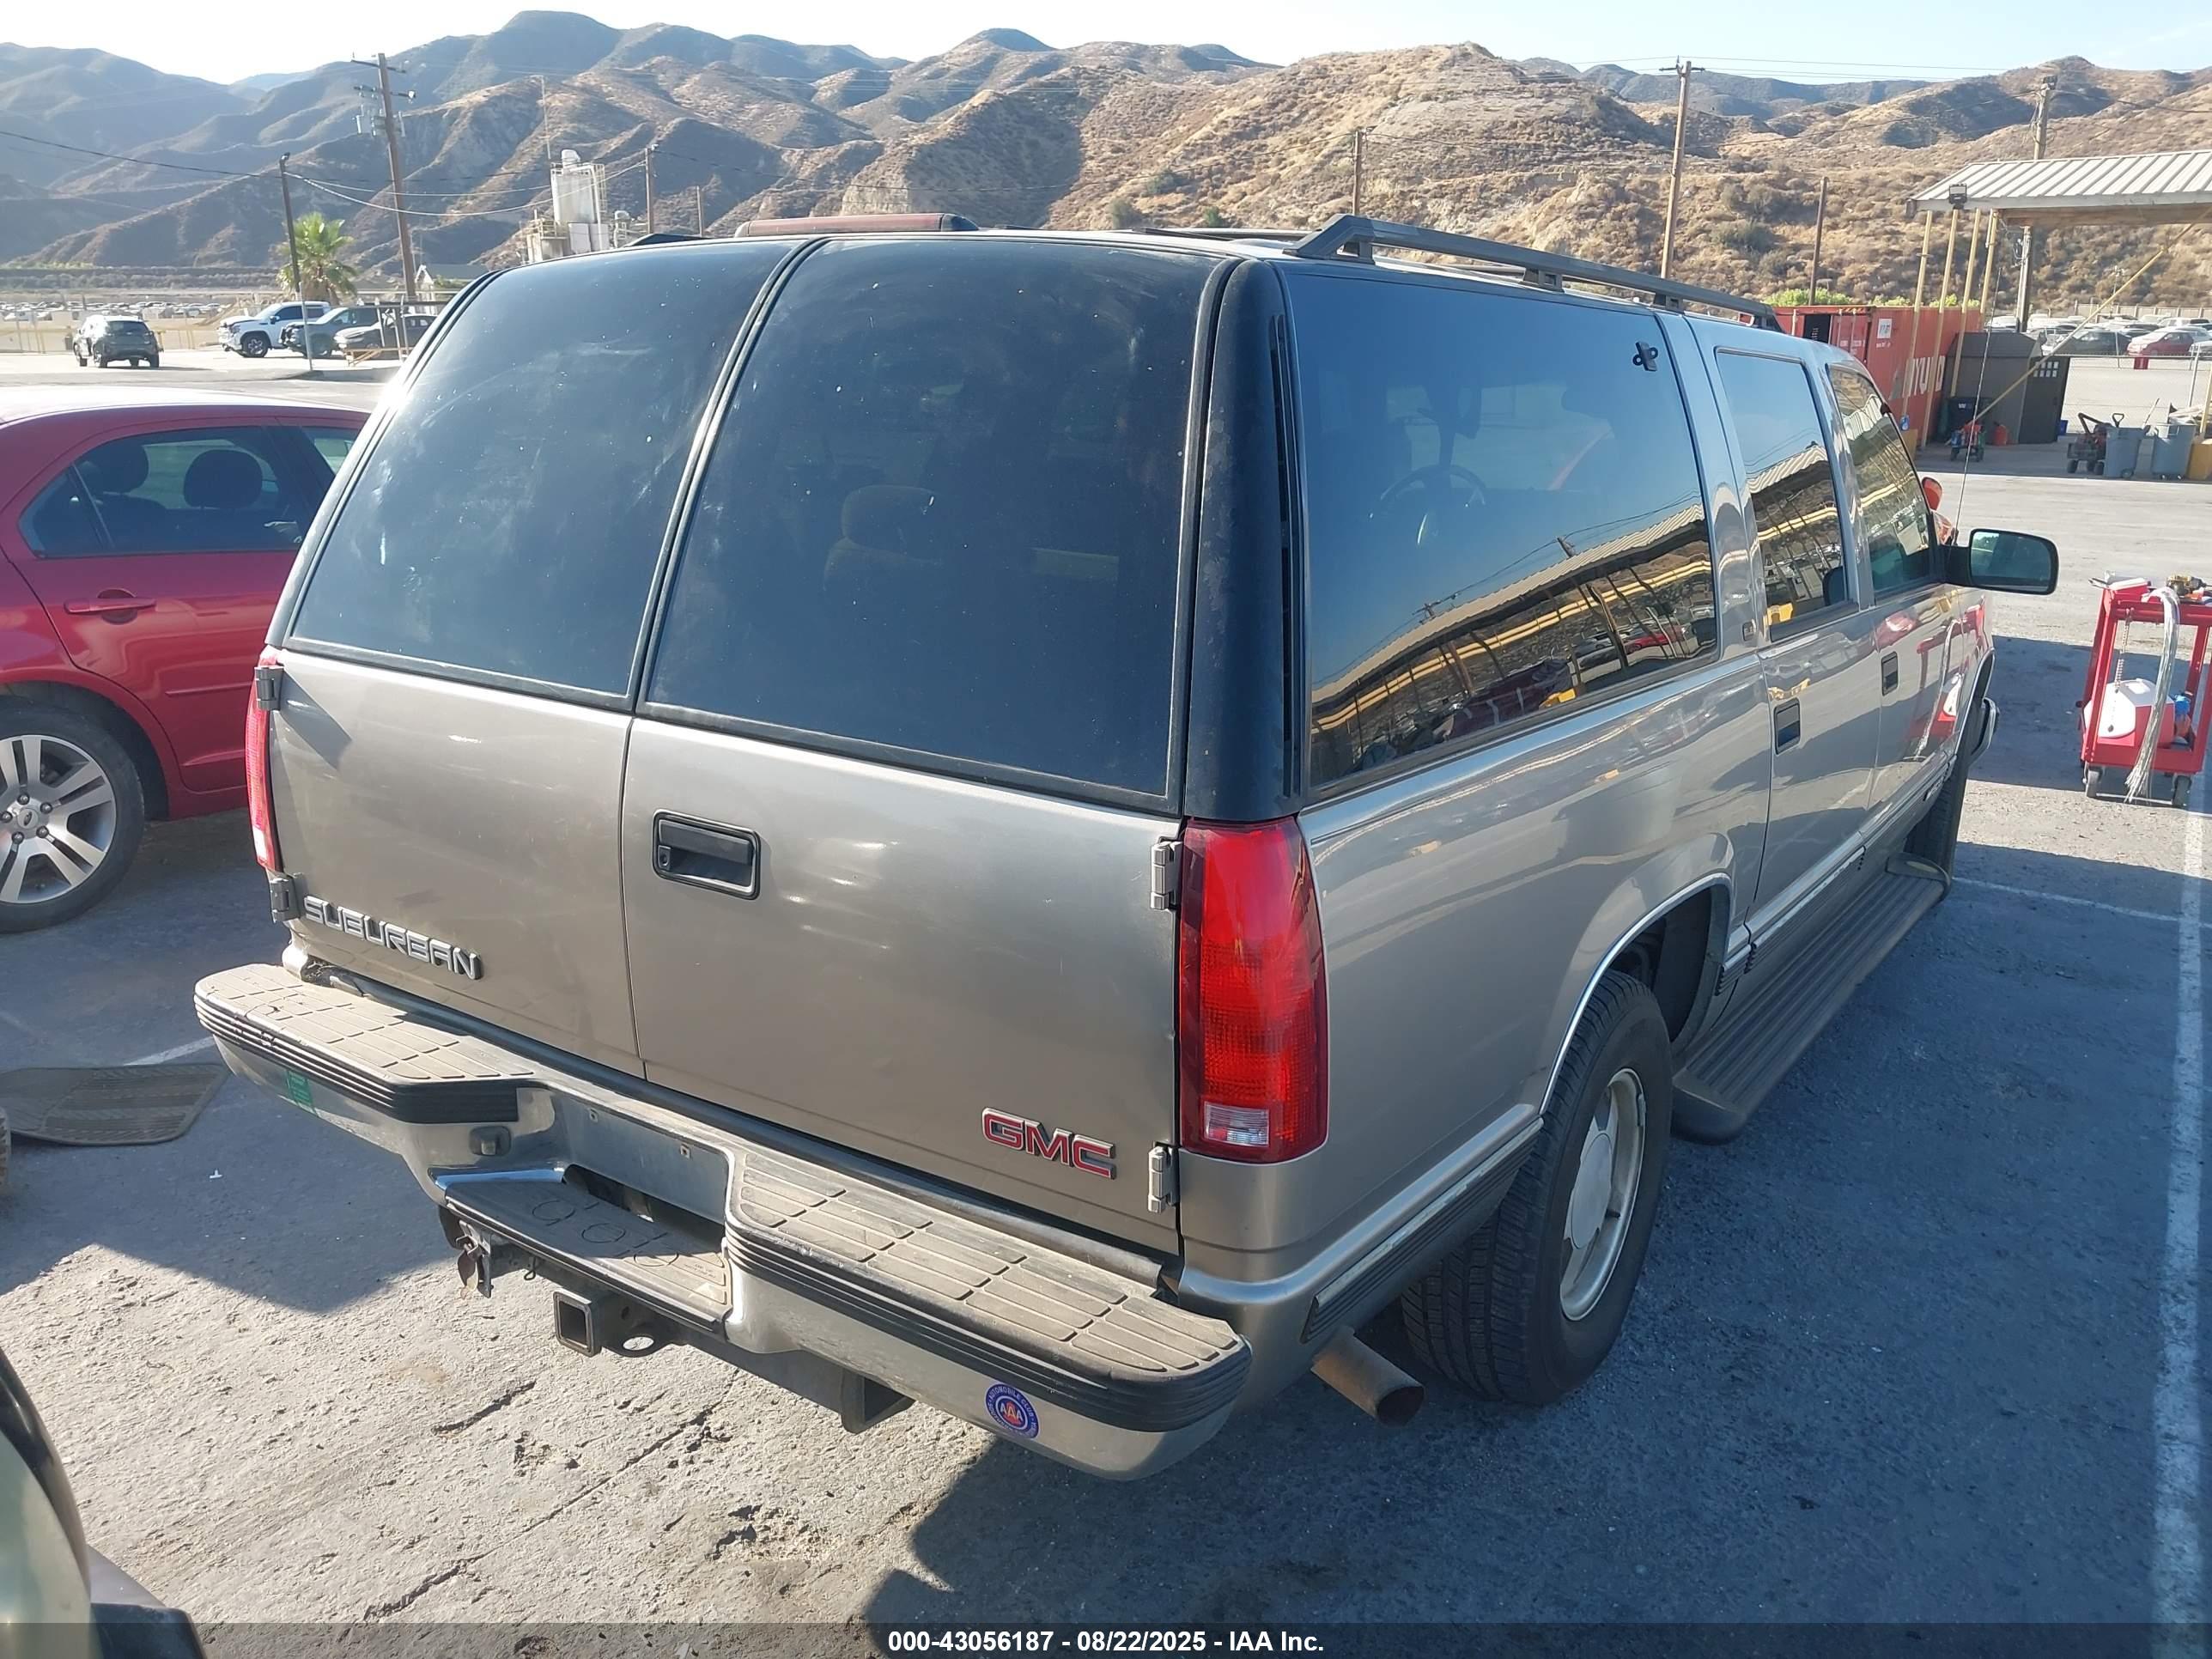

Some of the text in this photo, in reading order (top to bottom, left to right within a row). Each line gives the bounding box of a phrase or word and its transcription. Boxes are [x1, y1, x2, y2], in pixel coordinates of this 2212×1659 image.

[304, 895, 483, 980] SUBURBAN
[981, 1106, 1116, 1180] GMC
[1000, 1402, 1024, 1423] AAA
